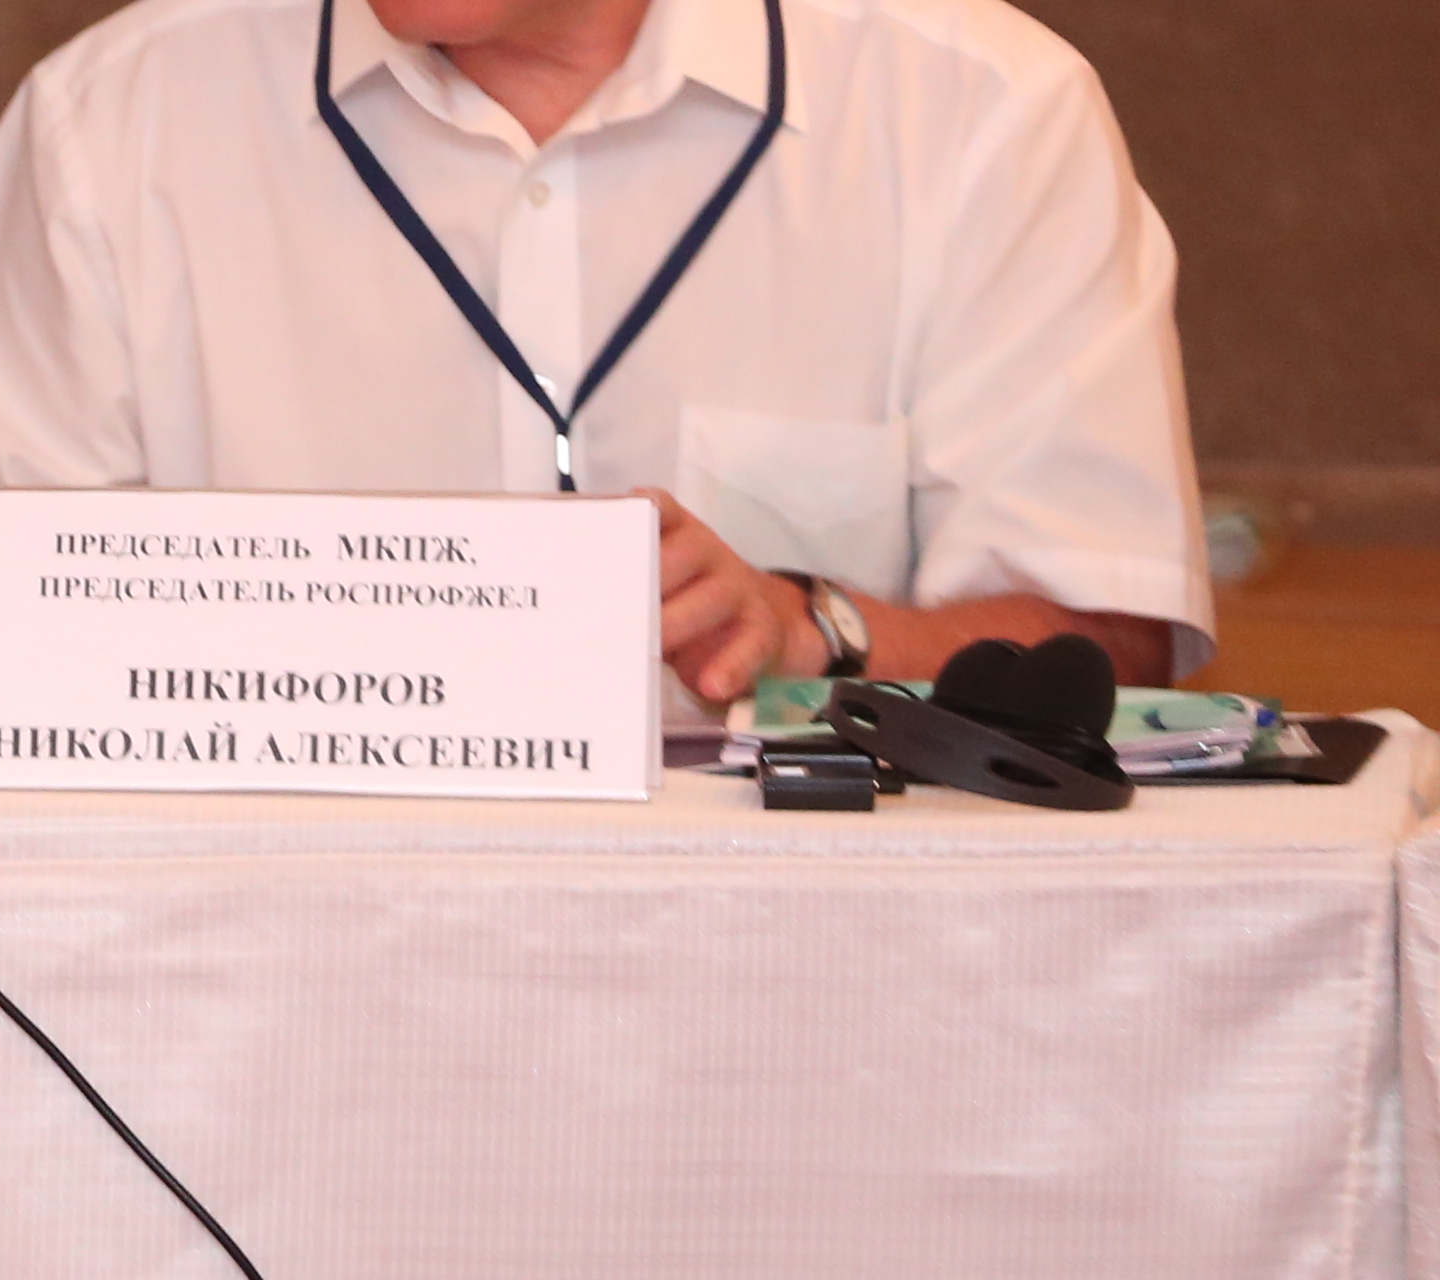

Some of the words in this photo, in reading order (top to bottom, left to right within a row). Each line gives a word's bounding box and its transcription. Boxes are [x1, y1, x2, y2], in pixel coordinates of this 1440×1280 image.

[56, 533, 310, 560] ПРЕДСЕДАТЕЛЬ
[338, 534, 477, 565] МКПЖ,
[40, 576, 294, 604] ПРЕДСЕДАТЕЛЬ
[306, 581, 538, 609] РОСПРОФЖЕЛ
[129, 668, 445, 706] НИКИФОРОВ
[257, 733, 591, 770] АЛЕКСЕЕВИЧ
